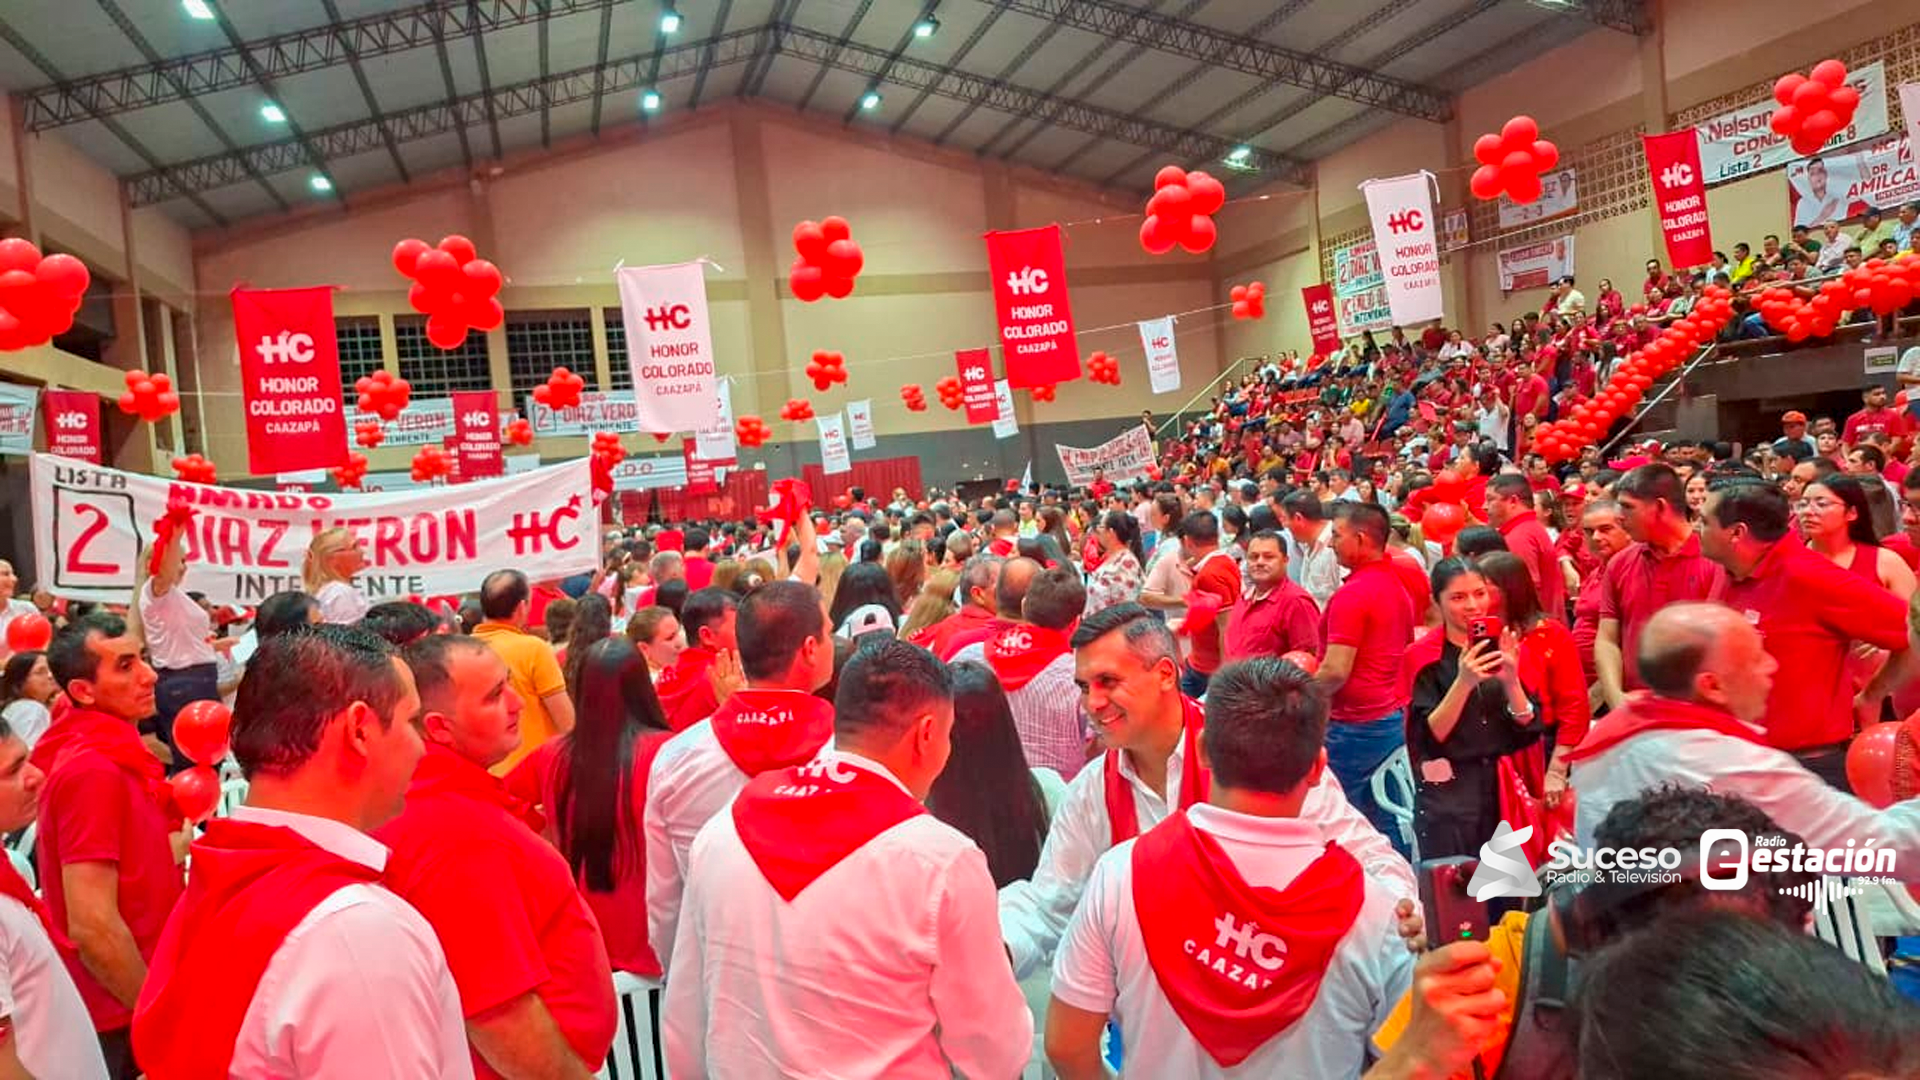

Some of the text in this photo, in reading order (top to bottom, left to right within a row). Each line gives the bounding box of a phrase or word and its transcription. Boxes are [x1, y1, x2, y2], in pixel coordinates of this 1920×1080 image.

[1720, 159, 1749, 177] Lista
[1753, 154, 1762, 169] 2
[1847, 125, 1857, 140] 8
[1660, 162, 1693, 188] HC
[1665, 195, 1700, 213] HONOR
[1387, 209, 1423, 234] HC
[1007, 267, 1049, 295] HC
[644, 304, 691, 331] HC
[1011, 304, 1053, 319] HONOR
[1003, 320, 1068, 339] COLORADO
[256, 331, 315, 363] HC
[650, 342, 699, 358] HONOR
[642, 362, 713, 379] COLORADO
[963, 366, 985, 381] HC
[260, 377, 319, 393] HONOR
[250, 398, 336, 416] COLORADO
[537, 403, 636, 427] 2 DIAZ VERO
[55, 411, 87, 429] HC
[462, 411, 490, 428] HC
[54, 465, 127, 489] LISTA
[66, 502, 121, 575] 2
[1215, 912, 1288, 971] HC
